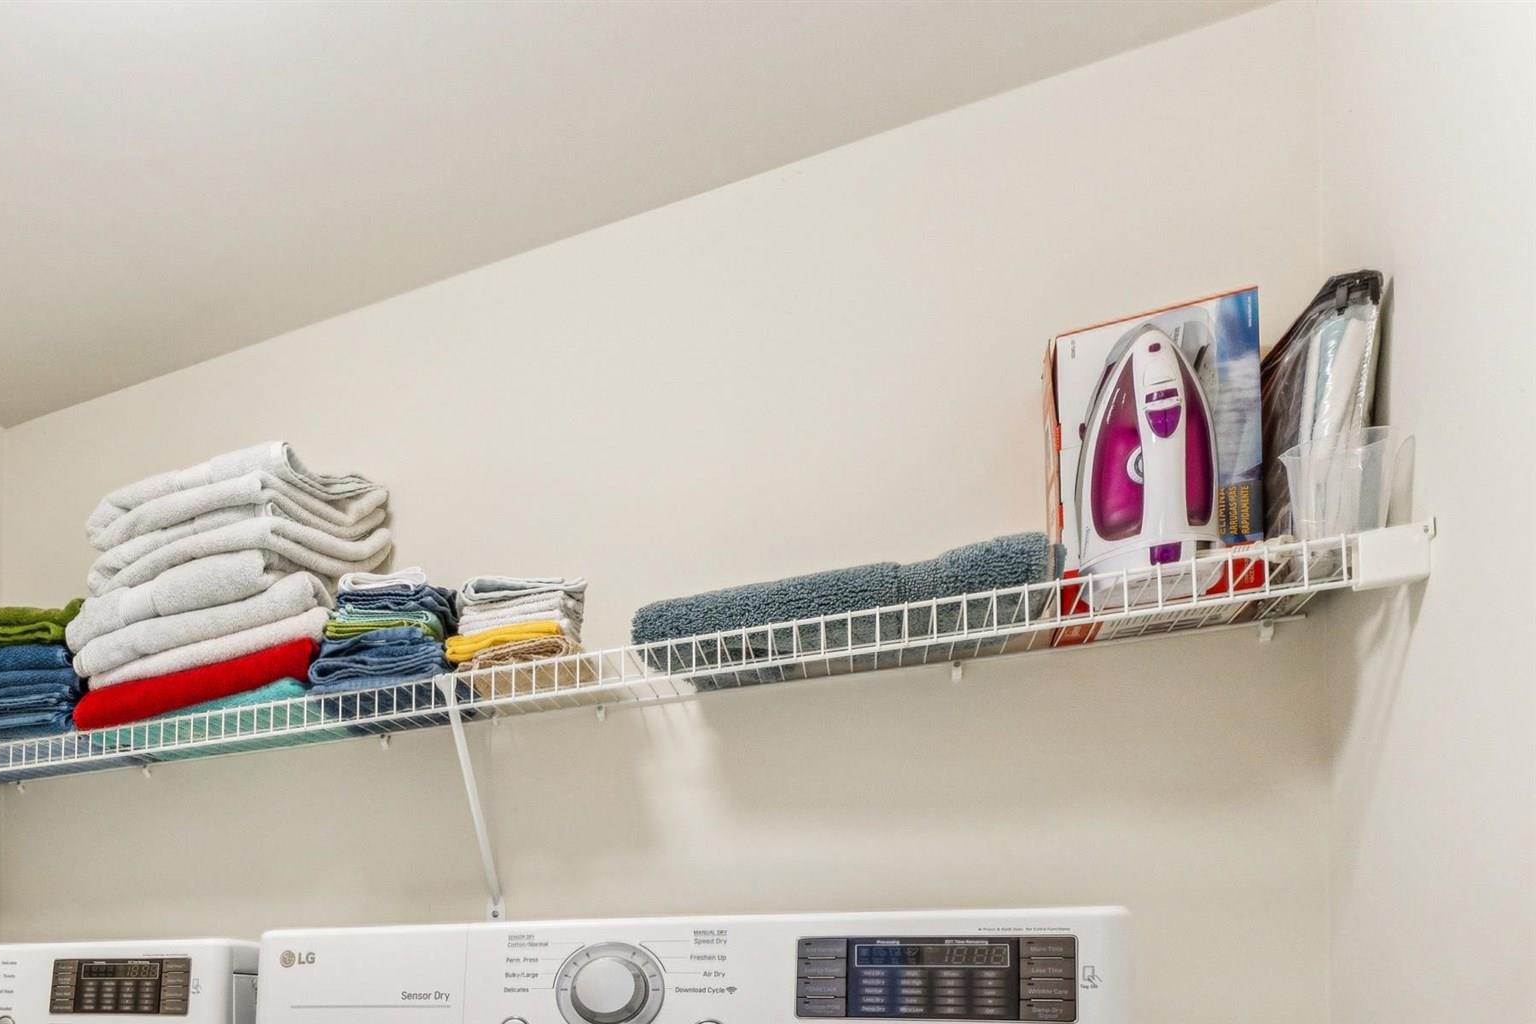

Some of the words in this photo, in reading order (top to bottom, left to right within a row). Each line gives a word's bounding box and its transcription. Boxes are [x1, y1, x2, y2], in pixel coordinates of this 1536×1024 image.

[1228, 502, 1238, 535] ARRUGAS
[401, 991, 432, 1001] Sensor
[434, 991, 450, 1002] Dry
